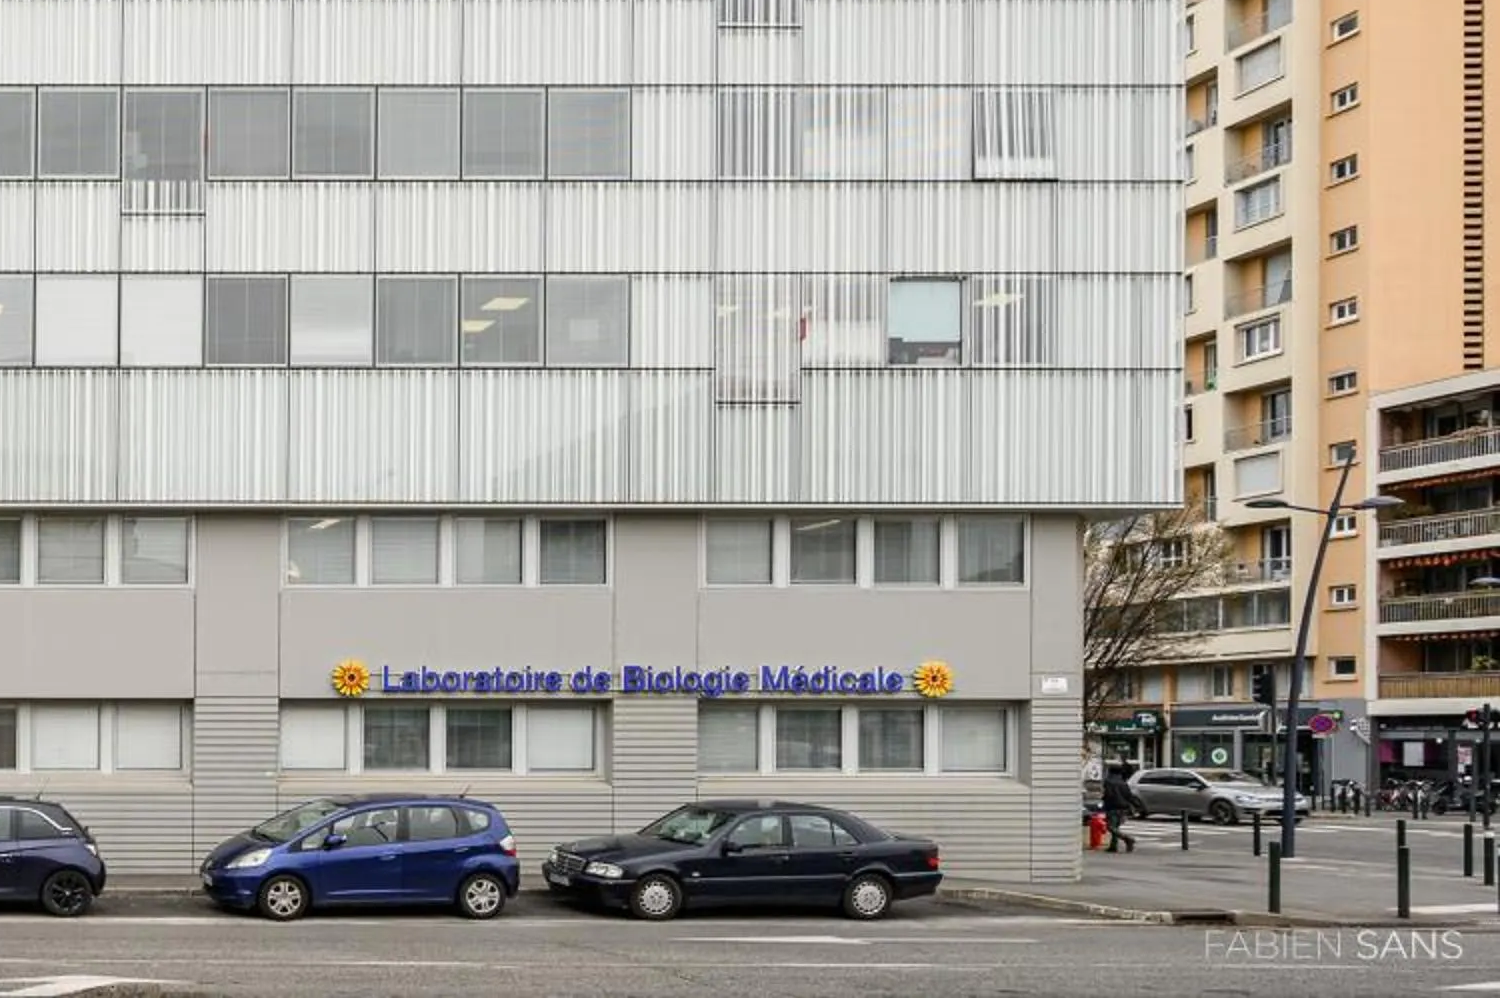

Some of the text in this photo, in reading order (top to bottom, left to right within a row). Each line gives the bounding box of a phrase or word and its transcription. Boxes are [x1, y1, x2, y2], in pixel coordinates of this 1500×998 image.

[382, 664, 906, 698] Laboratoire de Biologie Médicale
